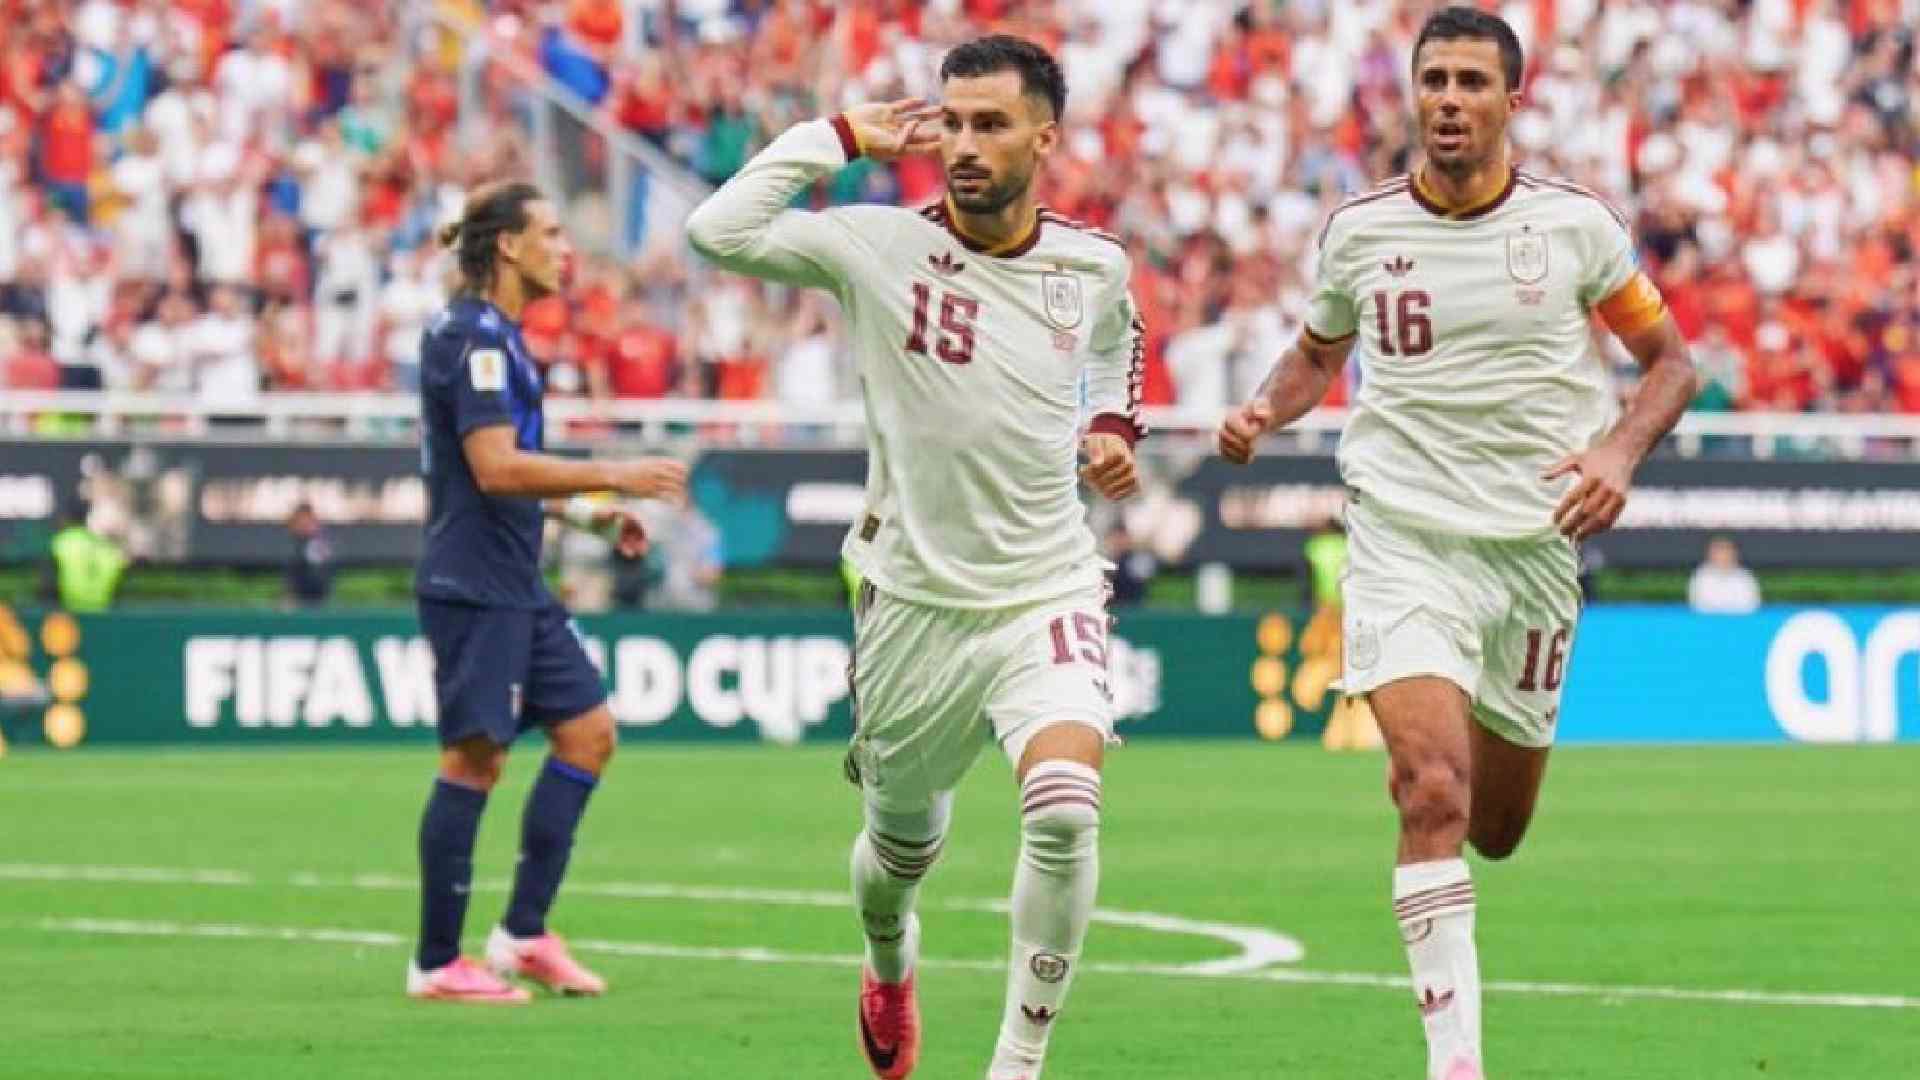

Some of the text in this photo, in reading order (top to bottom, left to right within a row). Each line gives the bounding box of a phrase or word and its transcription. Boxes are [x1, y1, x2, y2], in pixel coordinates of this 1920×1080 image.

[904, 280, 979, 364] 15
[1373, 289, 1433, 357] 16
[1049, 611, 1107, 668] 15
[1517, 627, 1567, 692] 16
[183, 635, 373, 727] FIFA
[687, 633, 852, 741] CUP
